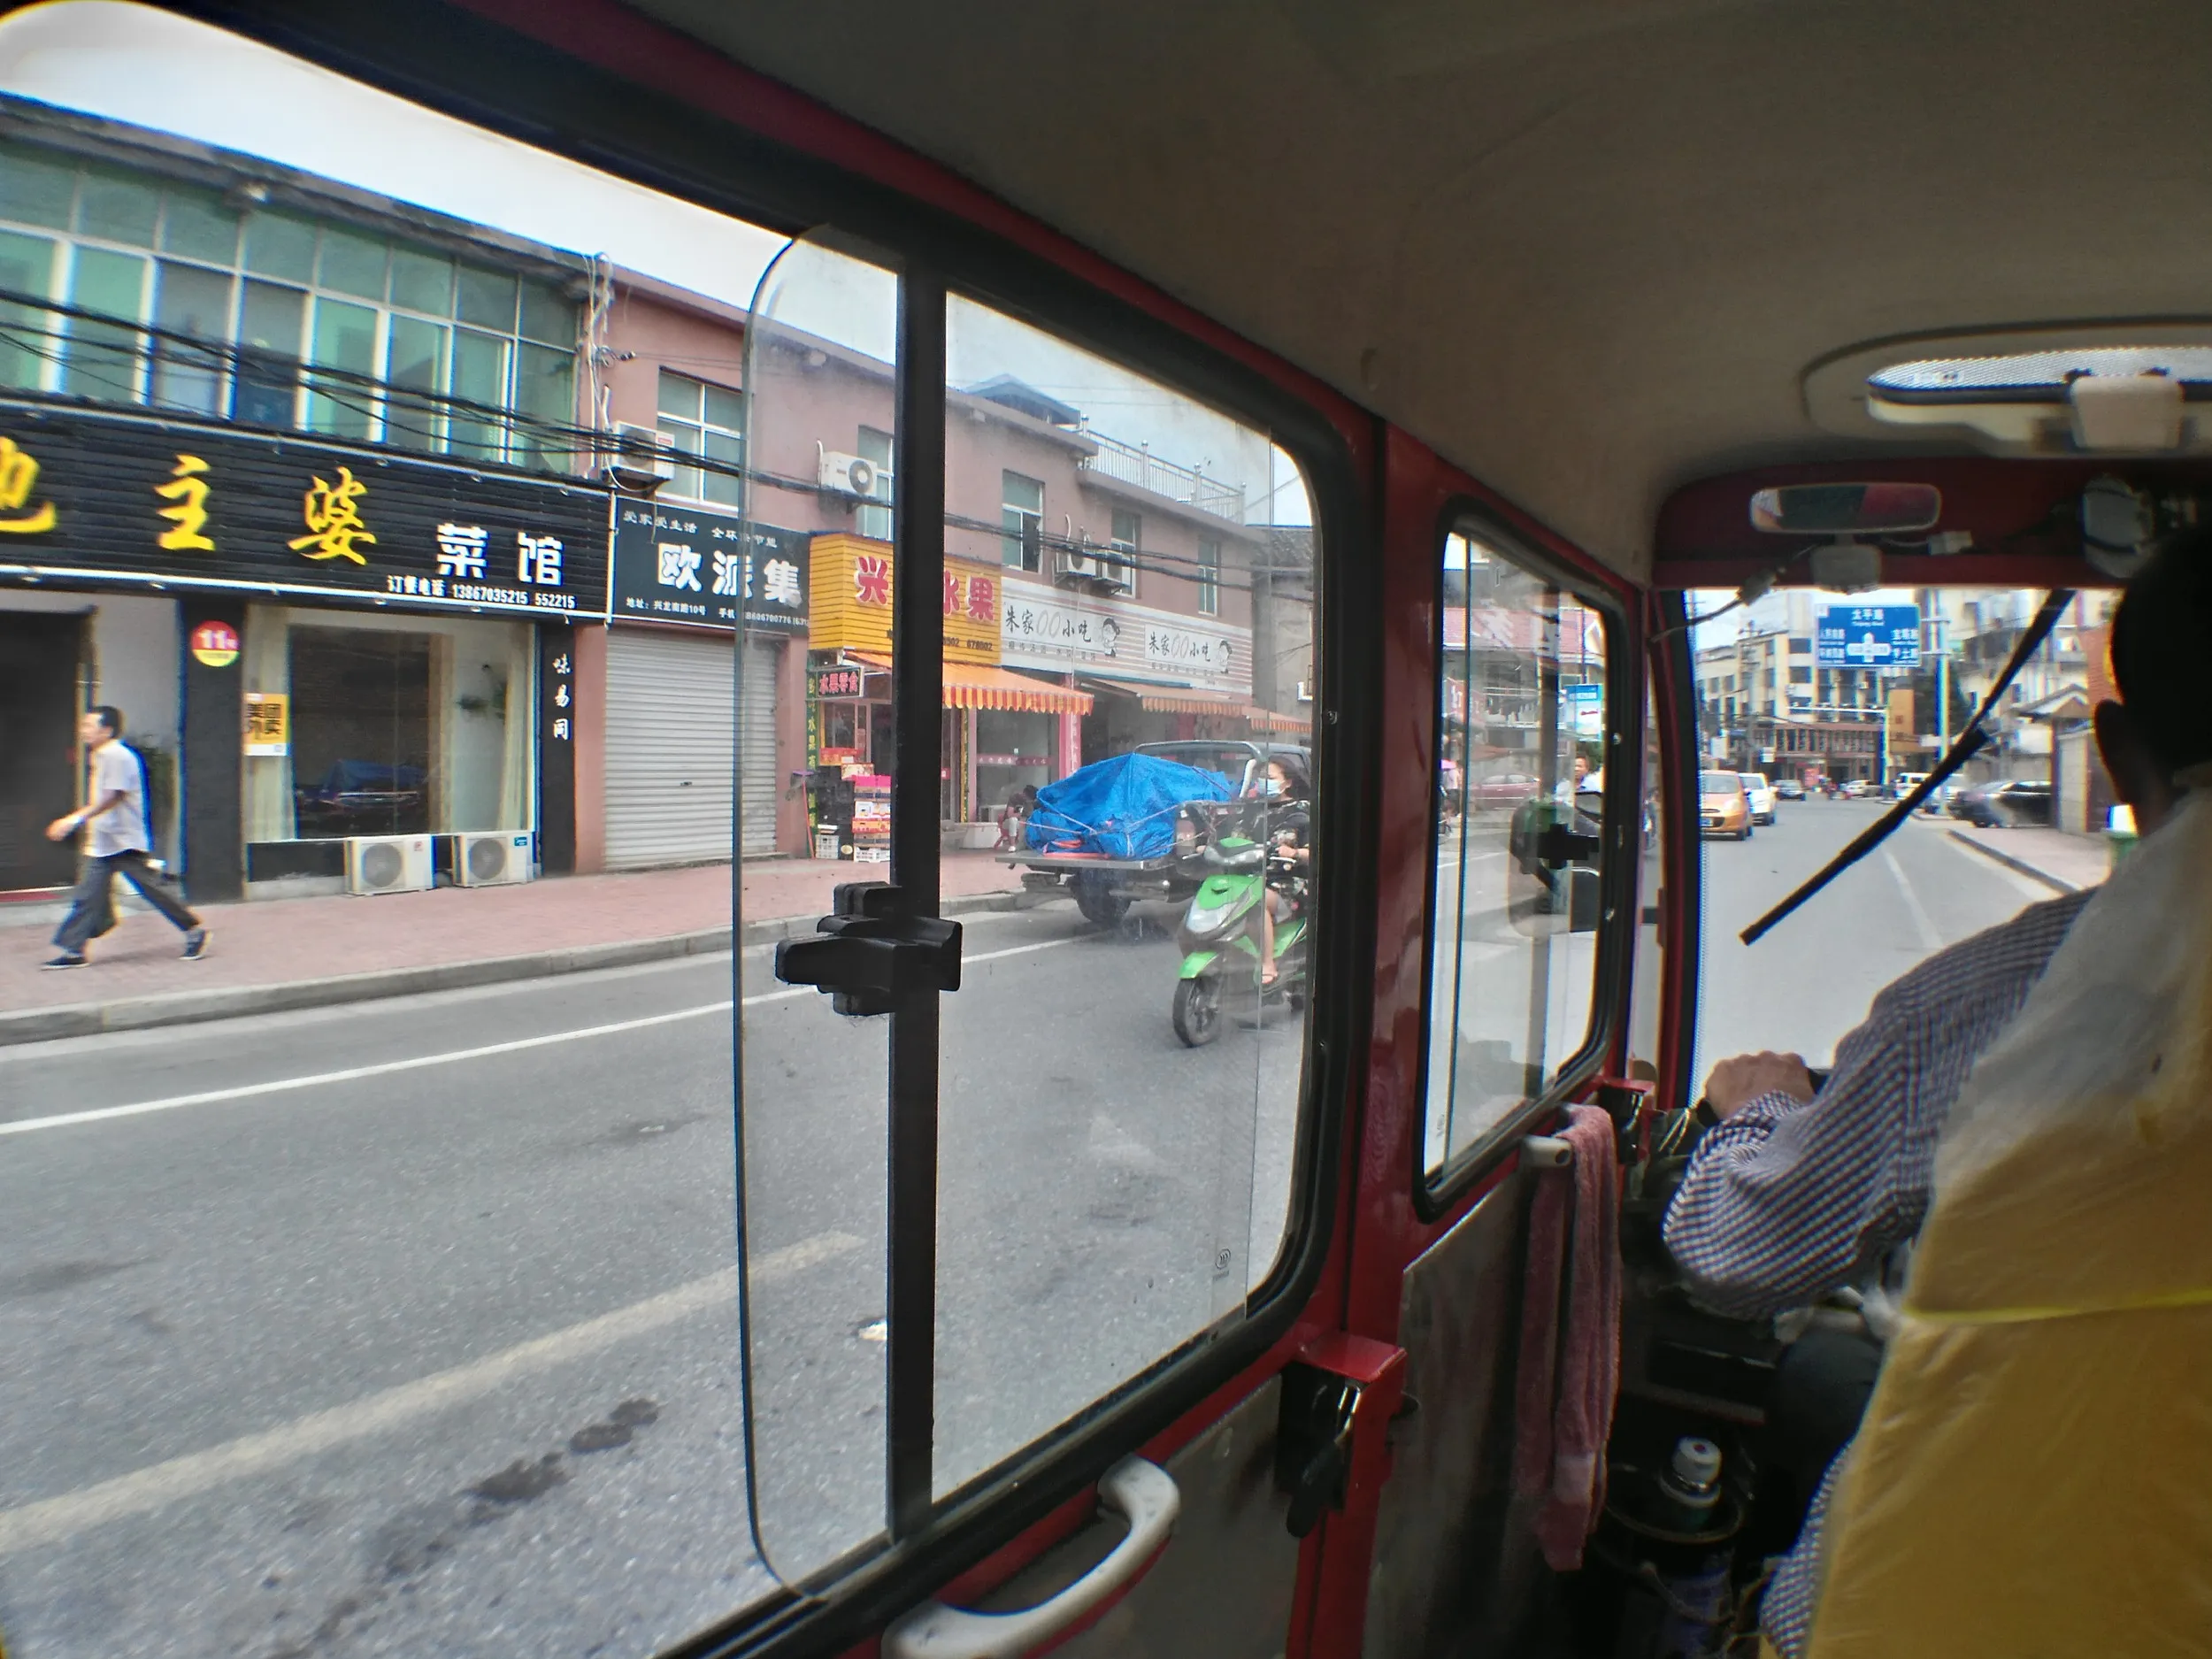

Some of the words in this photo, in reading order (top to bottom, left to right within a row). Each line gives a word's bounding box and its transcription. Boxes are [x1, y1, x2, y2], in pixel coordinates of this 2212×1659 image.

[437, 522, 564, 587] 菜馆
[451, 583, 529, 605] 13867035215
[534, 592, 576, 610] 552215
[818, 671, 859, 695] 水果零食
